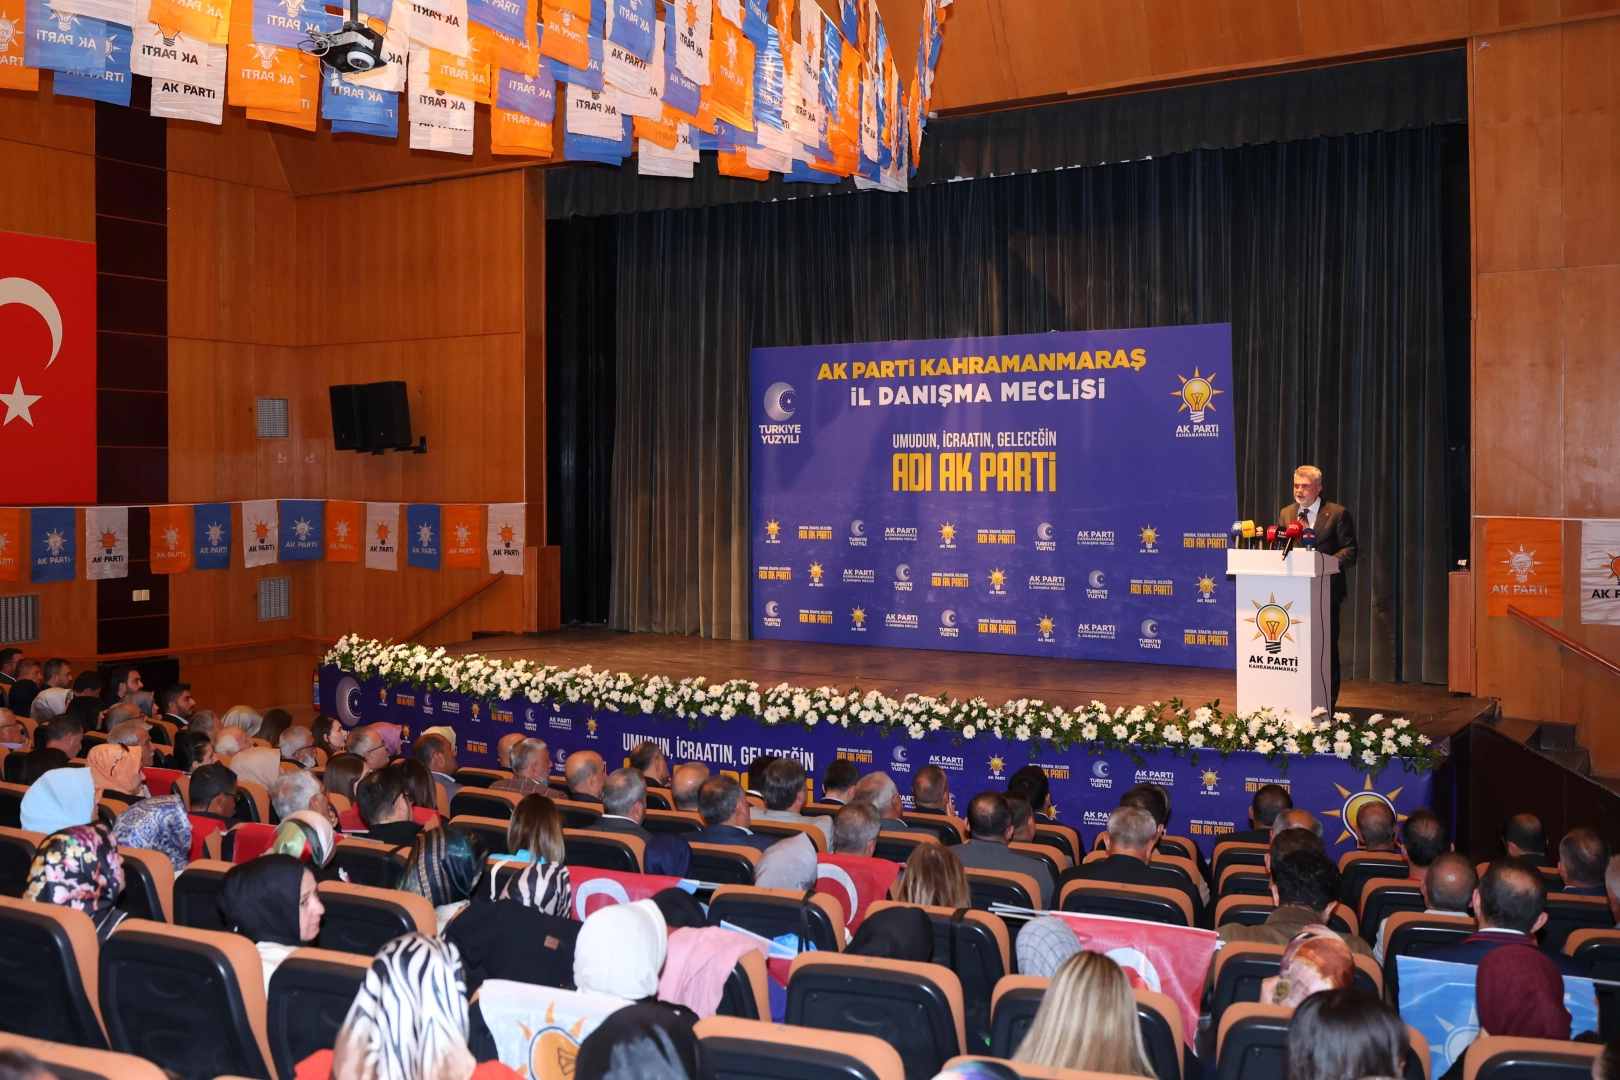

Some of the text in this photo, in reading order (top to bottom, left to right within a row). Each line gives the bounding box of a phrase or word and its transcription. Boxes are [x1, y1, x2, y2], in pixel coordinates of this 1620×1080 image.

[162, 83, 178, 92] AK
[817, 363, 847, 380] AK
[921, 348, 1146, 376] KAHRAMANMARAŞ
[878, 383, 992, 407] DANIŞMA
[1176, 425, 1190, 433] AK
[893, 428, 1056, 450] UMUDUN, İCRAATIN, GELECEĞİN
[893, 453, 932, 491] ADI
[940, 452, 972, 491] AK
[1492, 585, 1508, 593] AK
[1592, 589, 1610, 598] AK
[1249, 655, 1263, 664] AK
[1249, 664, 1297, 673] KAHRAMANMARAŞ
[676, 736, 736, 767] İCRAATIN,
